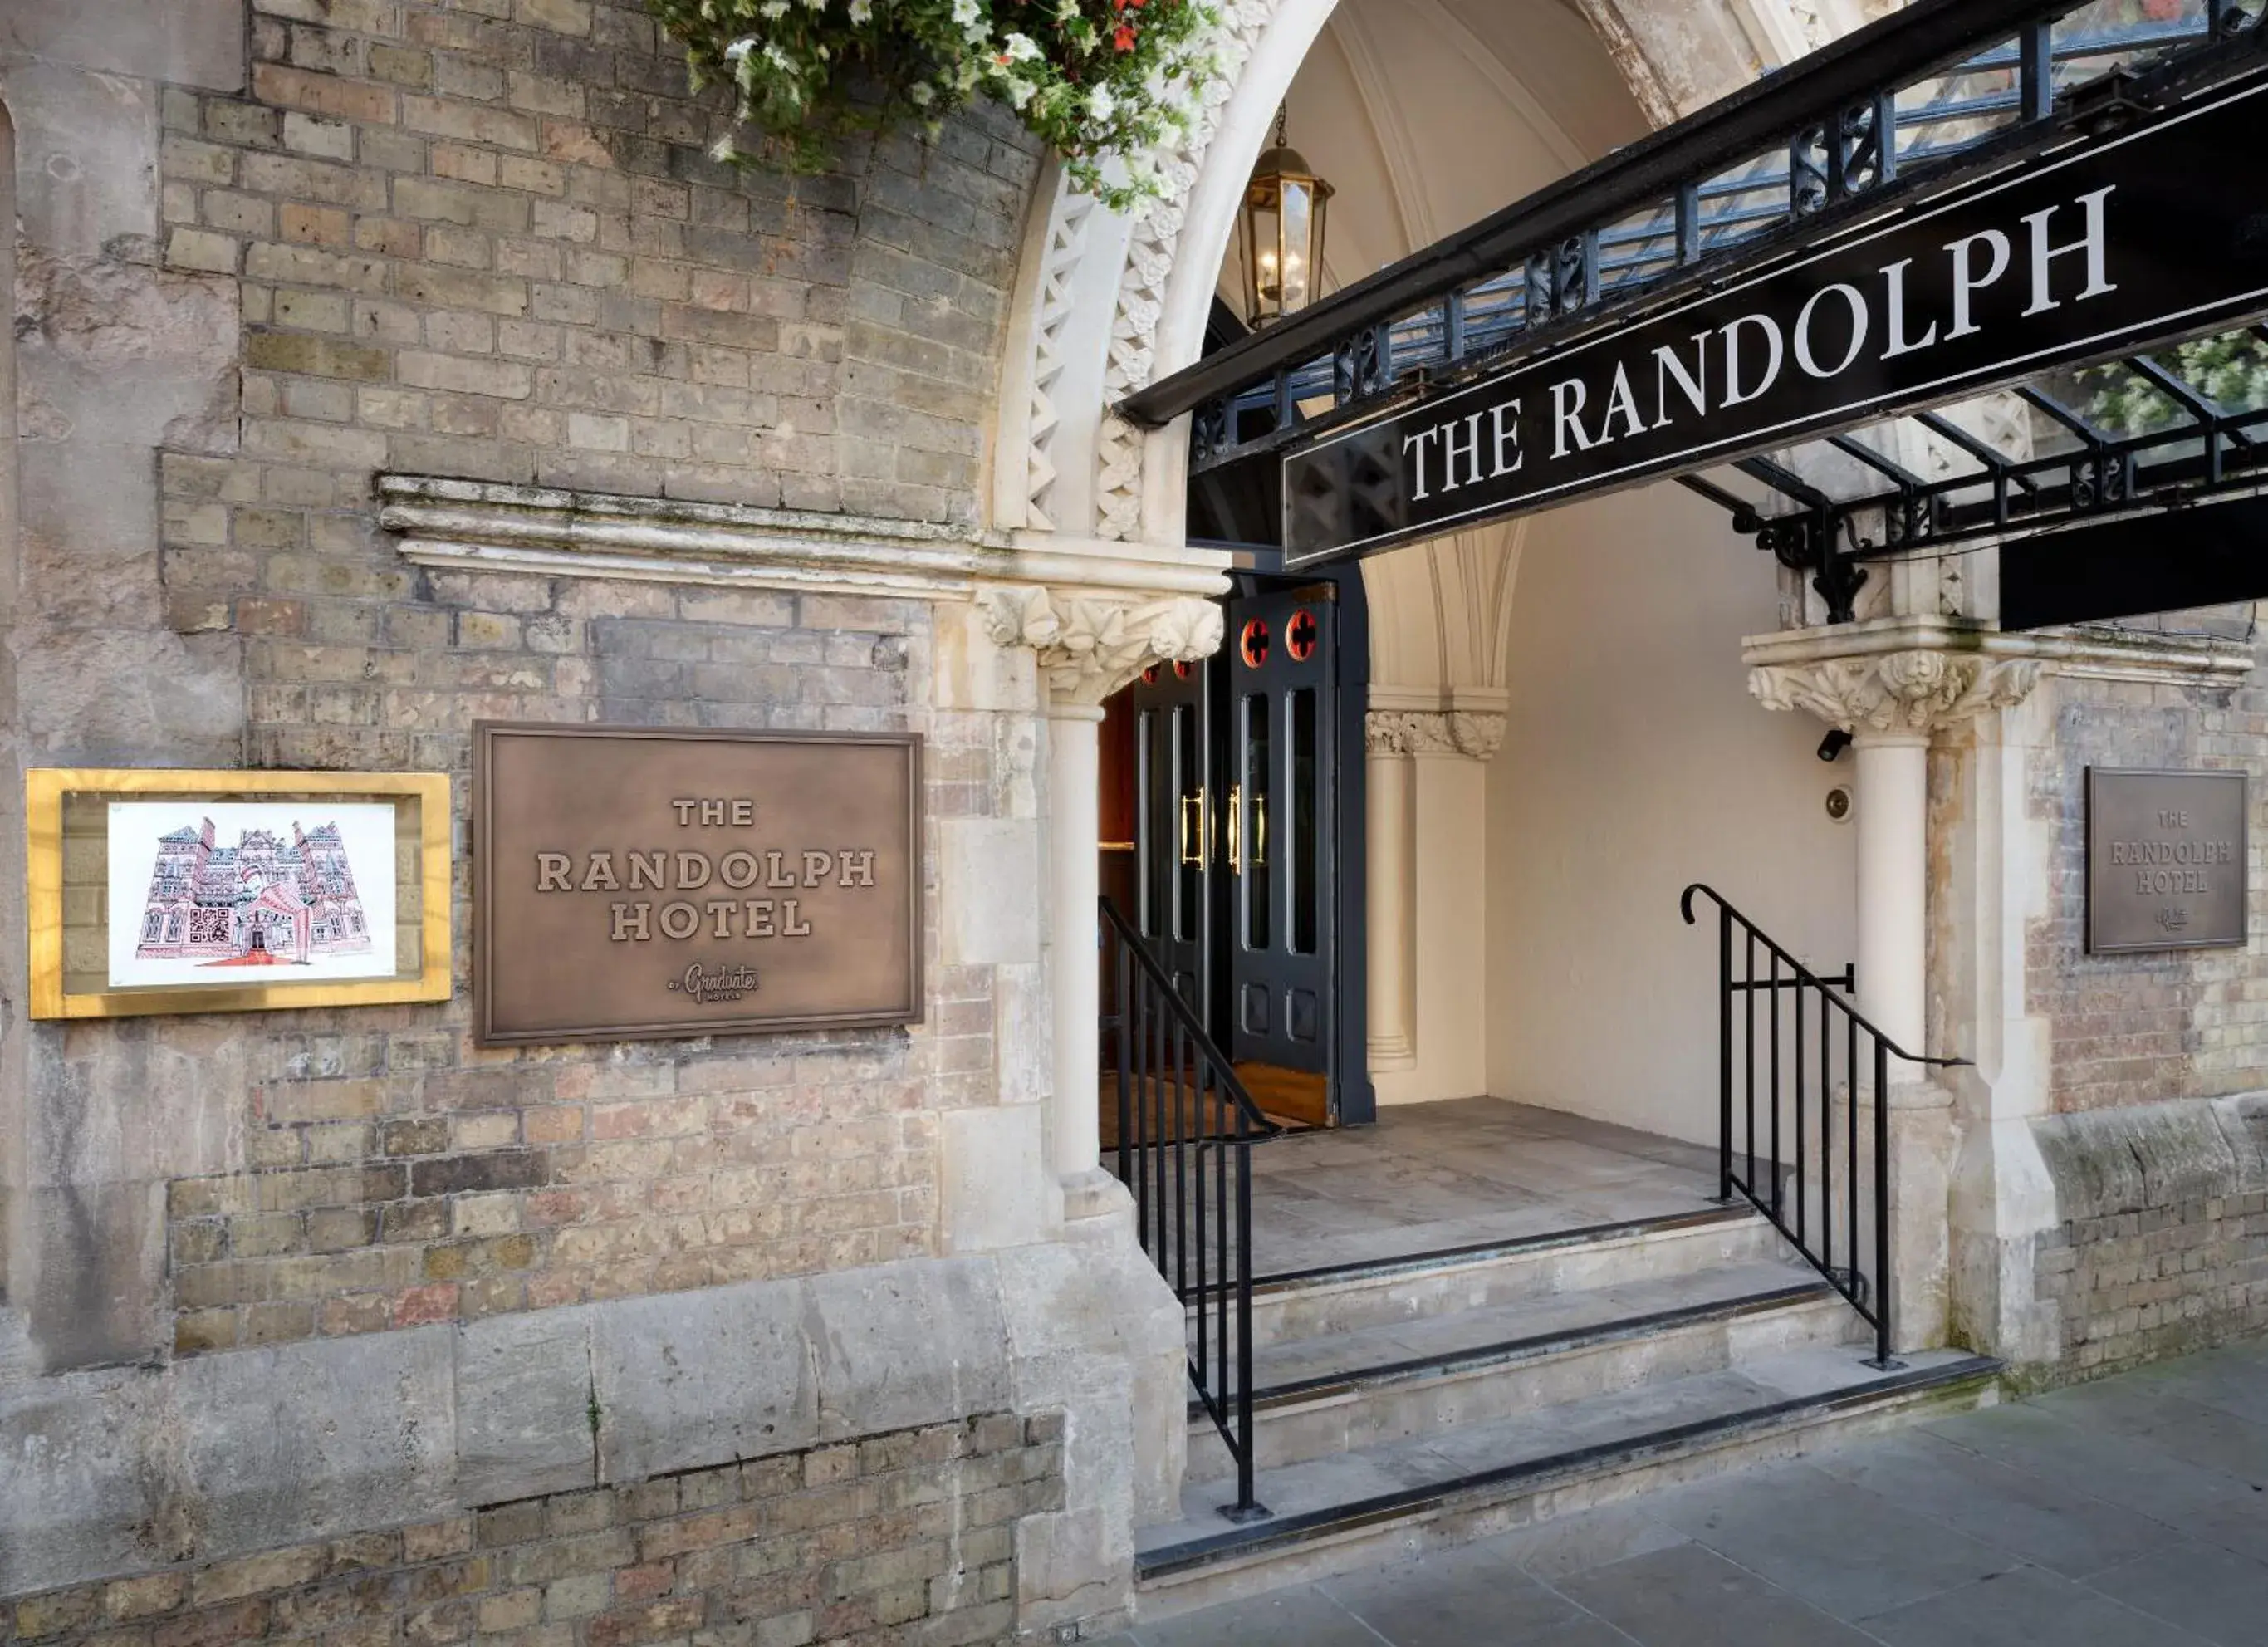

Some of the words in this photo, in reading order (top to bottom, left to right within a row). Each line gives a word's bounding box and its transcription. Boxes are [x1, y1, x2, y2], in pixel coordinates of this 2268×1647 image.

[1403, 398, 1524, 501] THE
[1548, 184, 2118, 461] RANDOLPH
[672, 799, 754, 826] THE
[2158, 810, 2189, 828] THE
[2111, 841, 2231, 865] RANDOLPH
[536, 850, 875, 891] RANDOLPH
[2136, 870, 2208, 895] HOTEL
[610, 899, 811, 941] HOTEL
[685, 963, 757, 1003] Graduate
